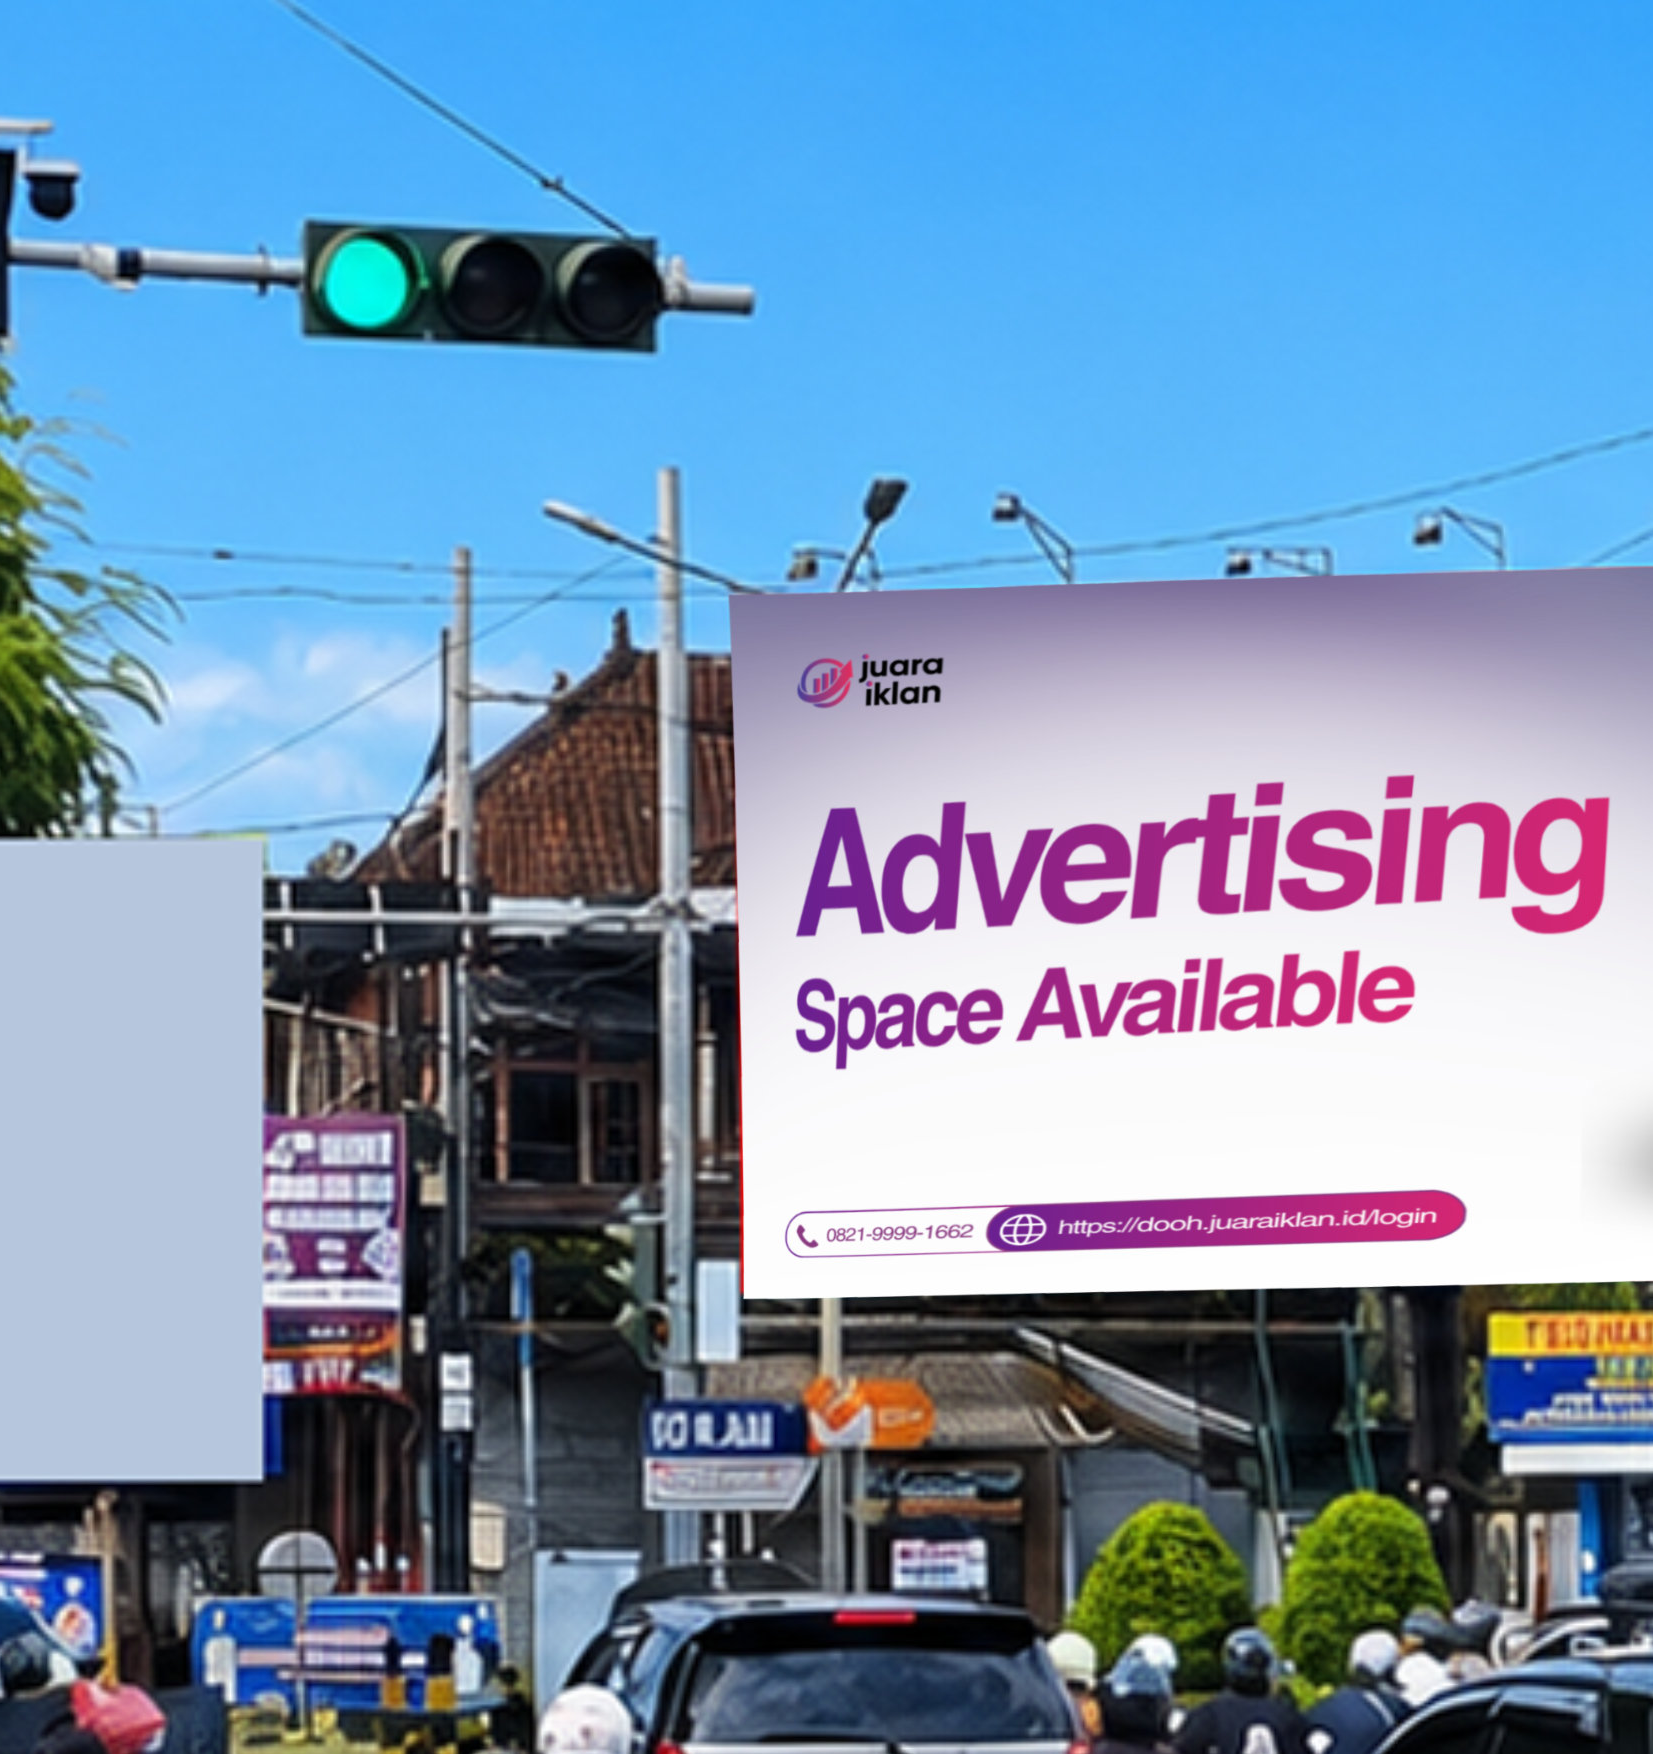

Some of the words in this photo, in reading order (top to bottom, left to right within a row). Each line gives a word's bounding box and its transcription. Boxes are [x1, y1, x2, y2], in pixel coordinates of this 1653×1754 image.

[859, 653, 944, 684] juara
[865, 680, 943, 707] iklan
[797, 775, 1610, 934] Advertising
[797, 978, 1003, 1070] Space
[1016, 950, 1415, 1041] Available
[826, 1223, 974, 1243] 0821-9999-1662
[1057, 1208, 1437, 1238] https://dooh.juaraiklan.id/login
